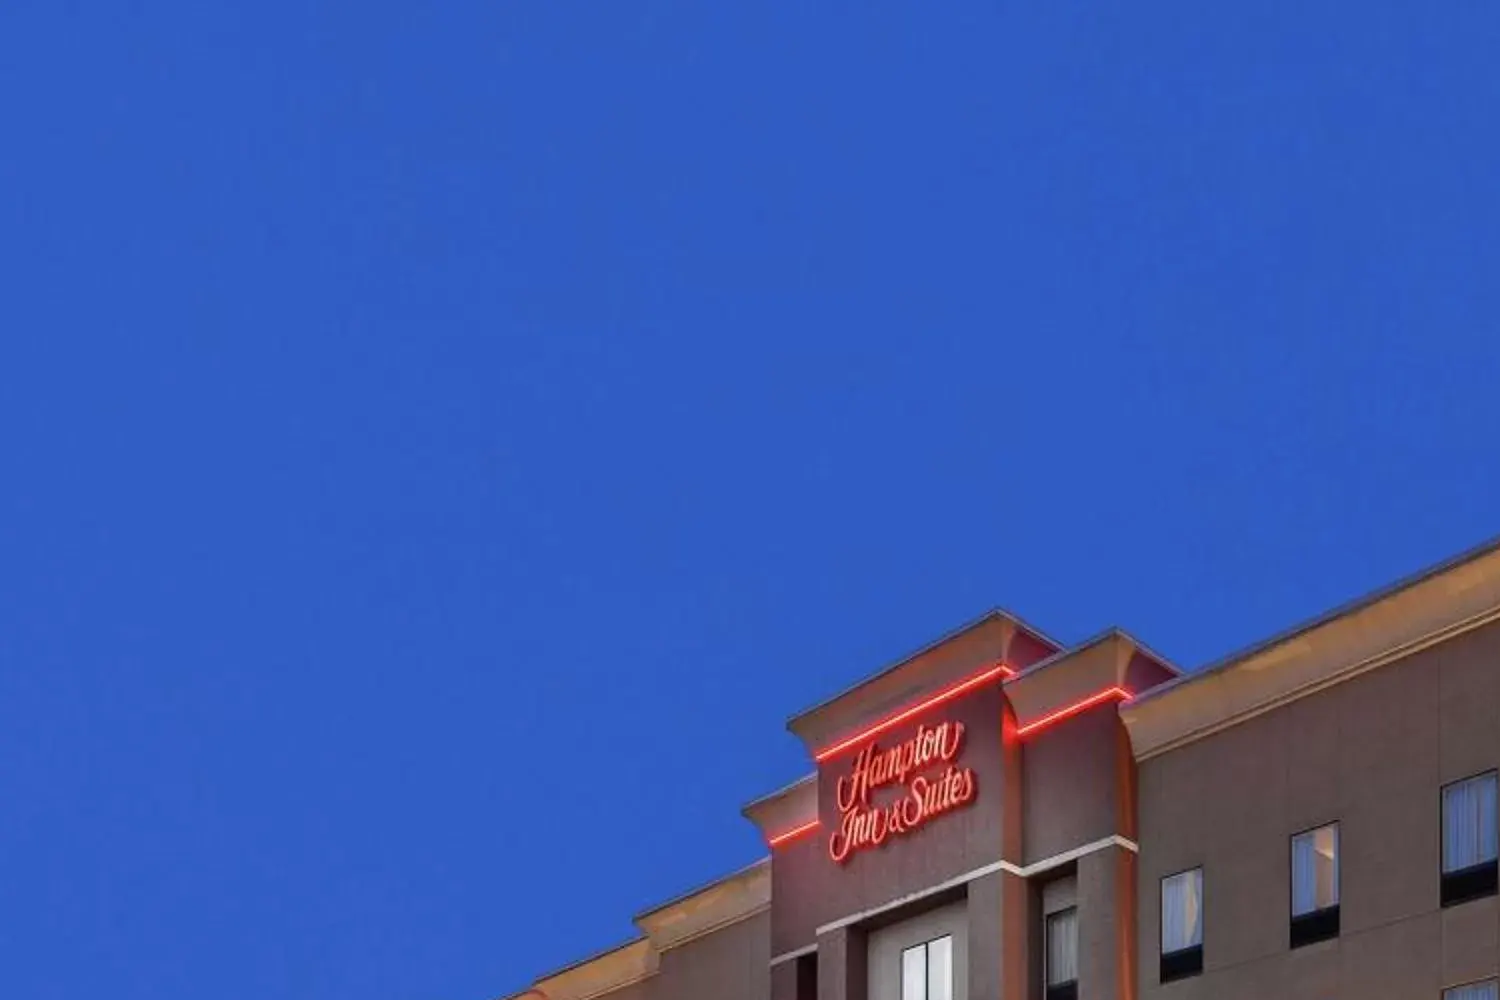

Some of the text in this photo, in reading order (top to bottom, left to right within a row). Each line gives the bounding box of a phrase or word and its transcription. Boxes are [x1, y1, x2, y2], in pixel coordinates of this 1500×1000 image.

[837, 720, 966, 812] Hampton
[829, 765, 974, 862] Inn & Suites
